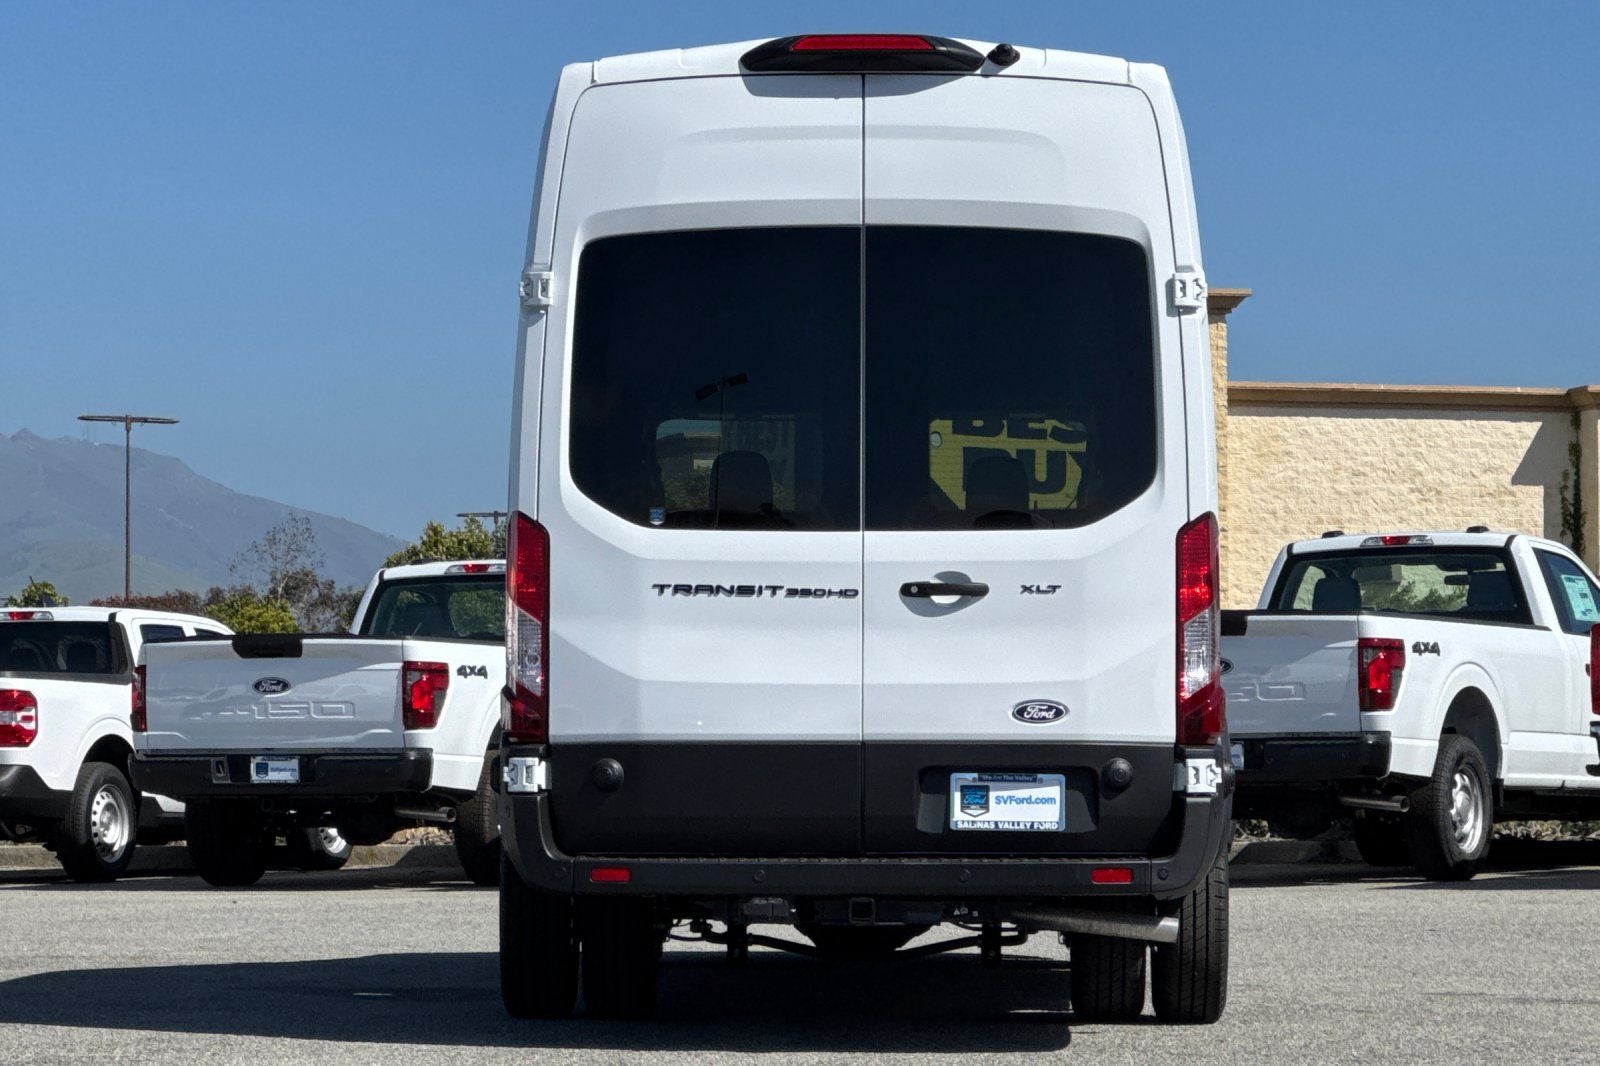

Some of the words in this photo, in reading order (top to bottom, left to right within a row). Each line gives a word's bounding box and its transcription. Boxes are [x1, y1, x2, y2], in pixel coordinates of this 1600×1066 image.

[652, 584, 784, 597] TRANSIT
[784, 588, 859, 599] 350HD
[1020, 584, 1062, 594] XLT
[1023, 705, 1056, 719] Ford
[995, 795, 1057, 805] SVFord.com
[957, 821, 995, 829] SALINAS
[997, 821, 1031, 829] VALLEY
[1034, 821, 1058, 830] FORD
